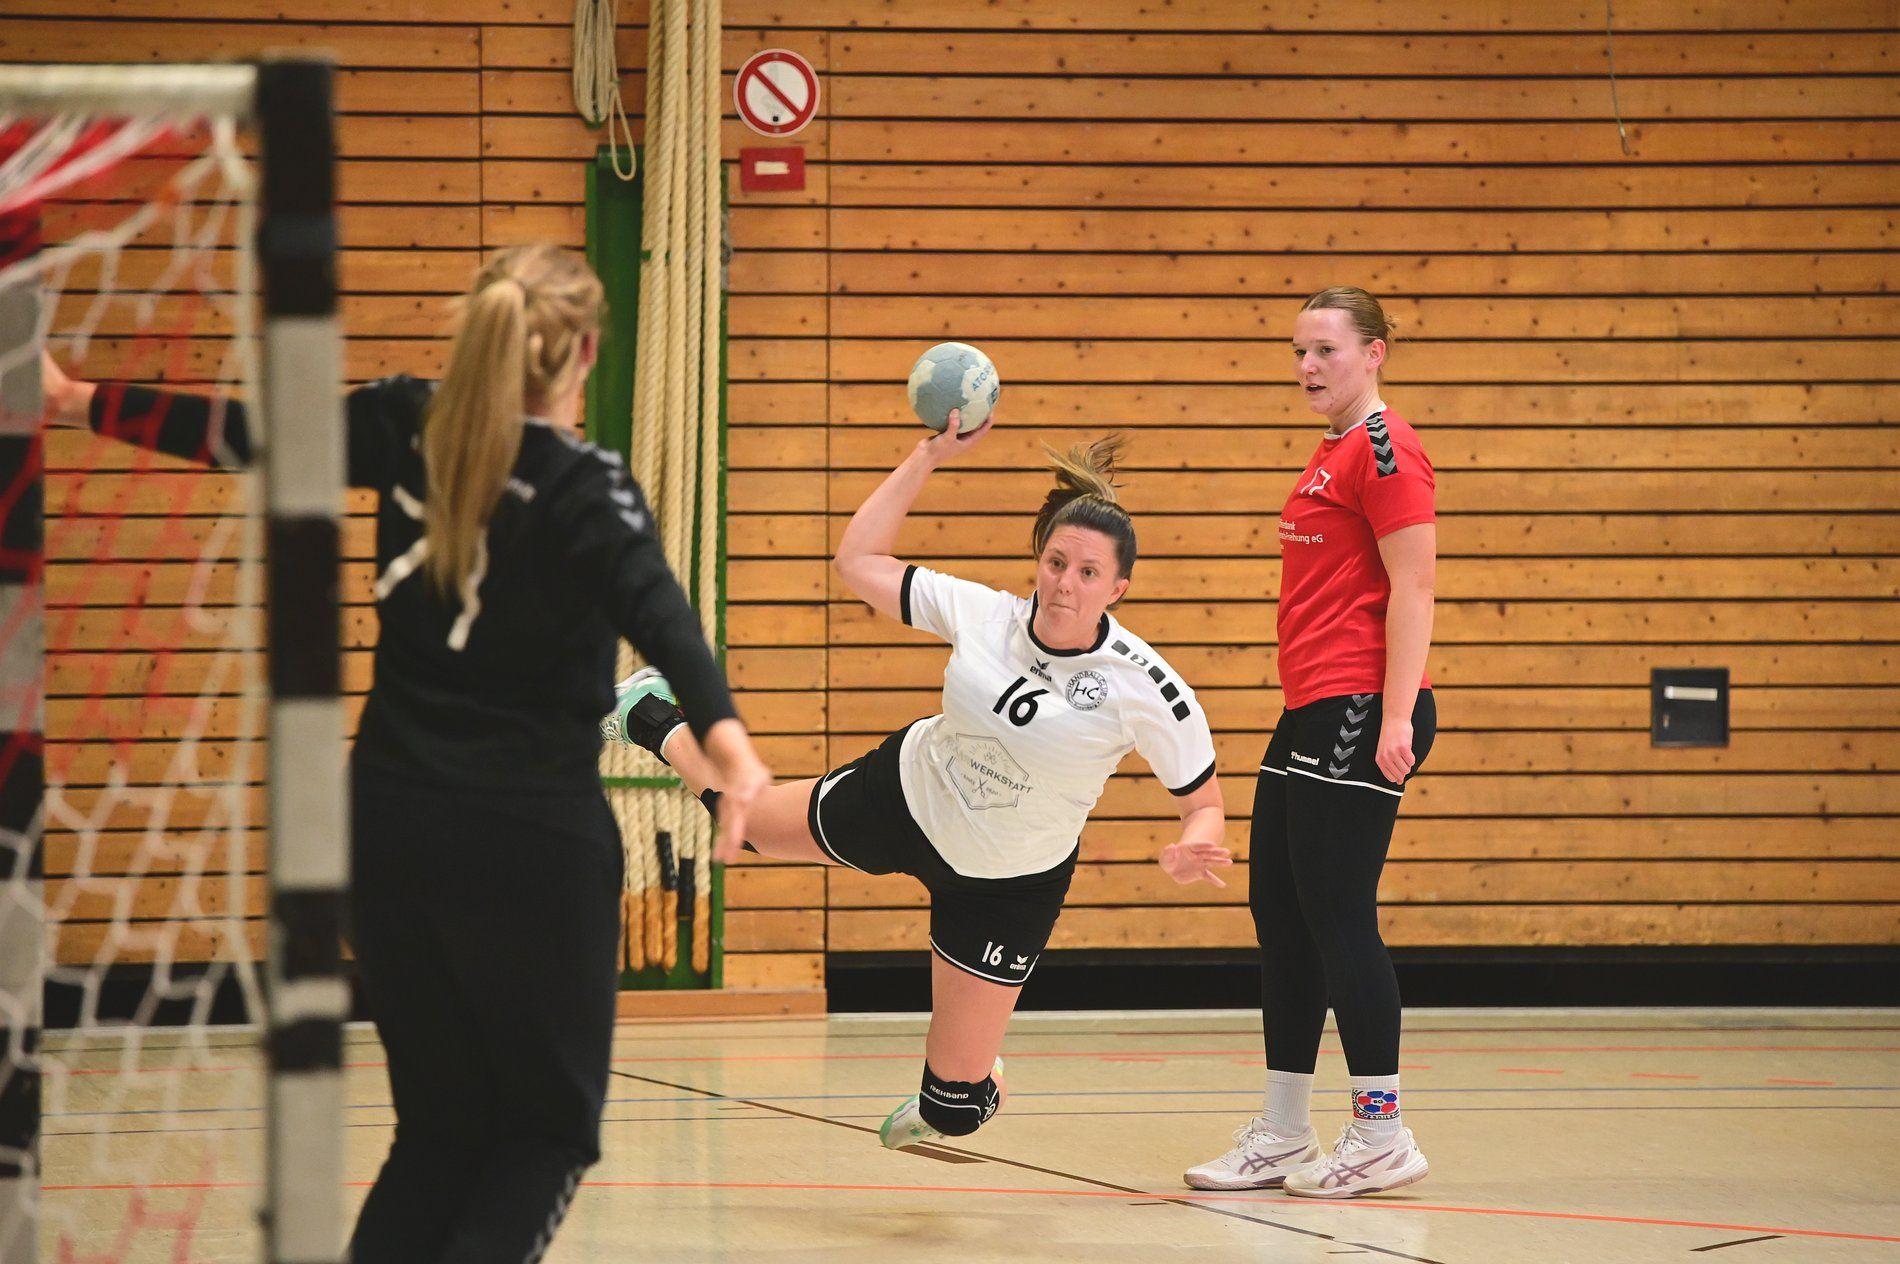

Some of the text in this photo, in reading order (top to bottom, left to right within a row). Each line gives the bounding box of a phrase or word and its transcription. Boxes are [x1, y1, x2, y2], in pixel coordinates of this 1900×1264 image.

[1311, 534, 1324, 543] eG
[992, 676, 1050, 727] 16
[969, 758, 1034, 794] WERKSTATT
[981, 940, 1005, 967] 16
